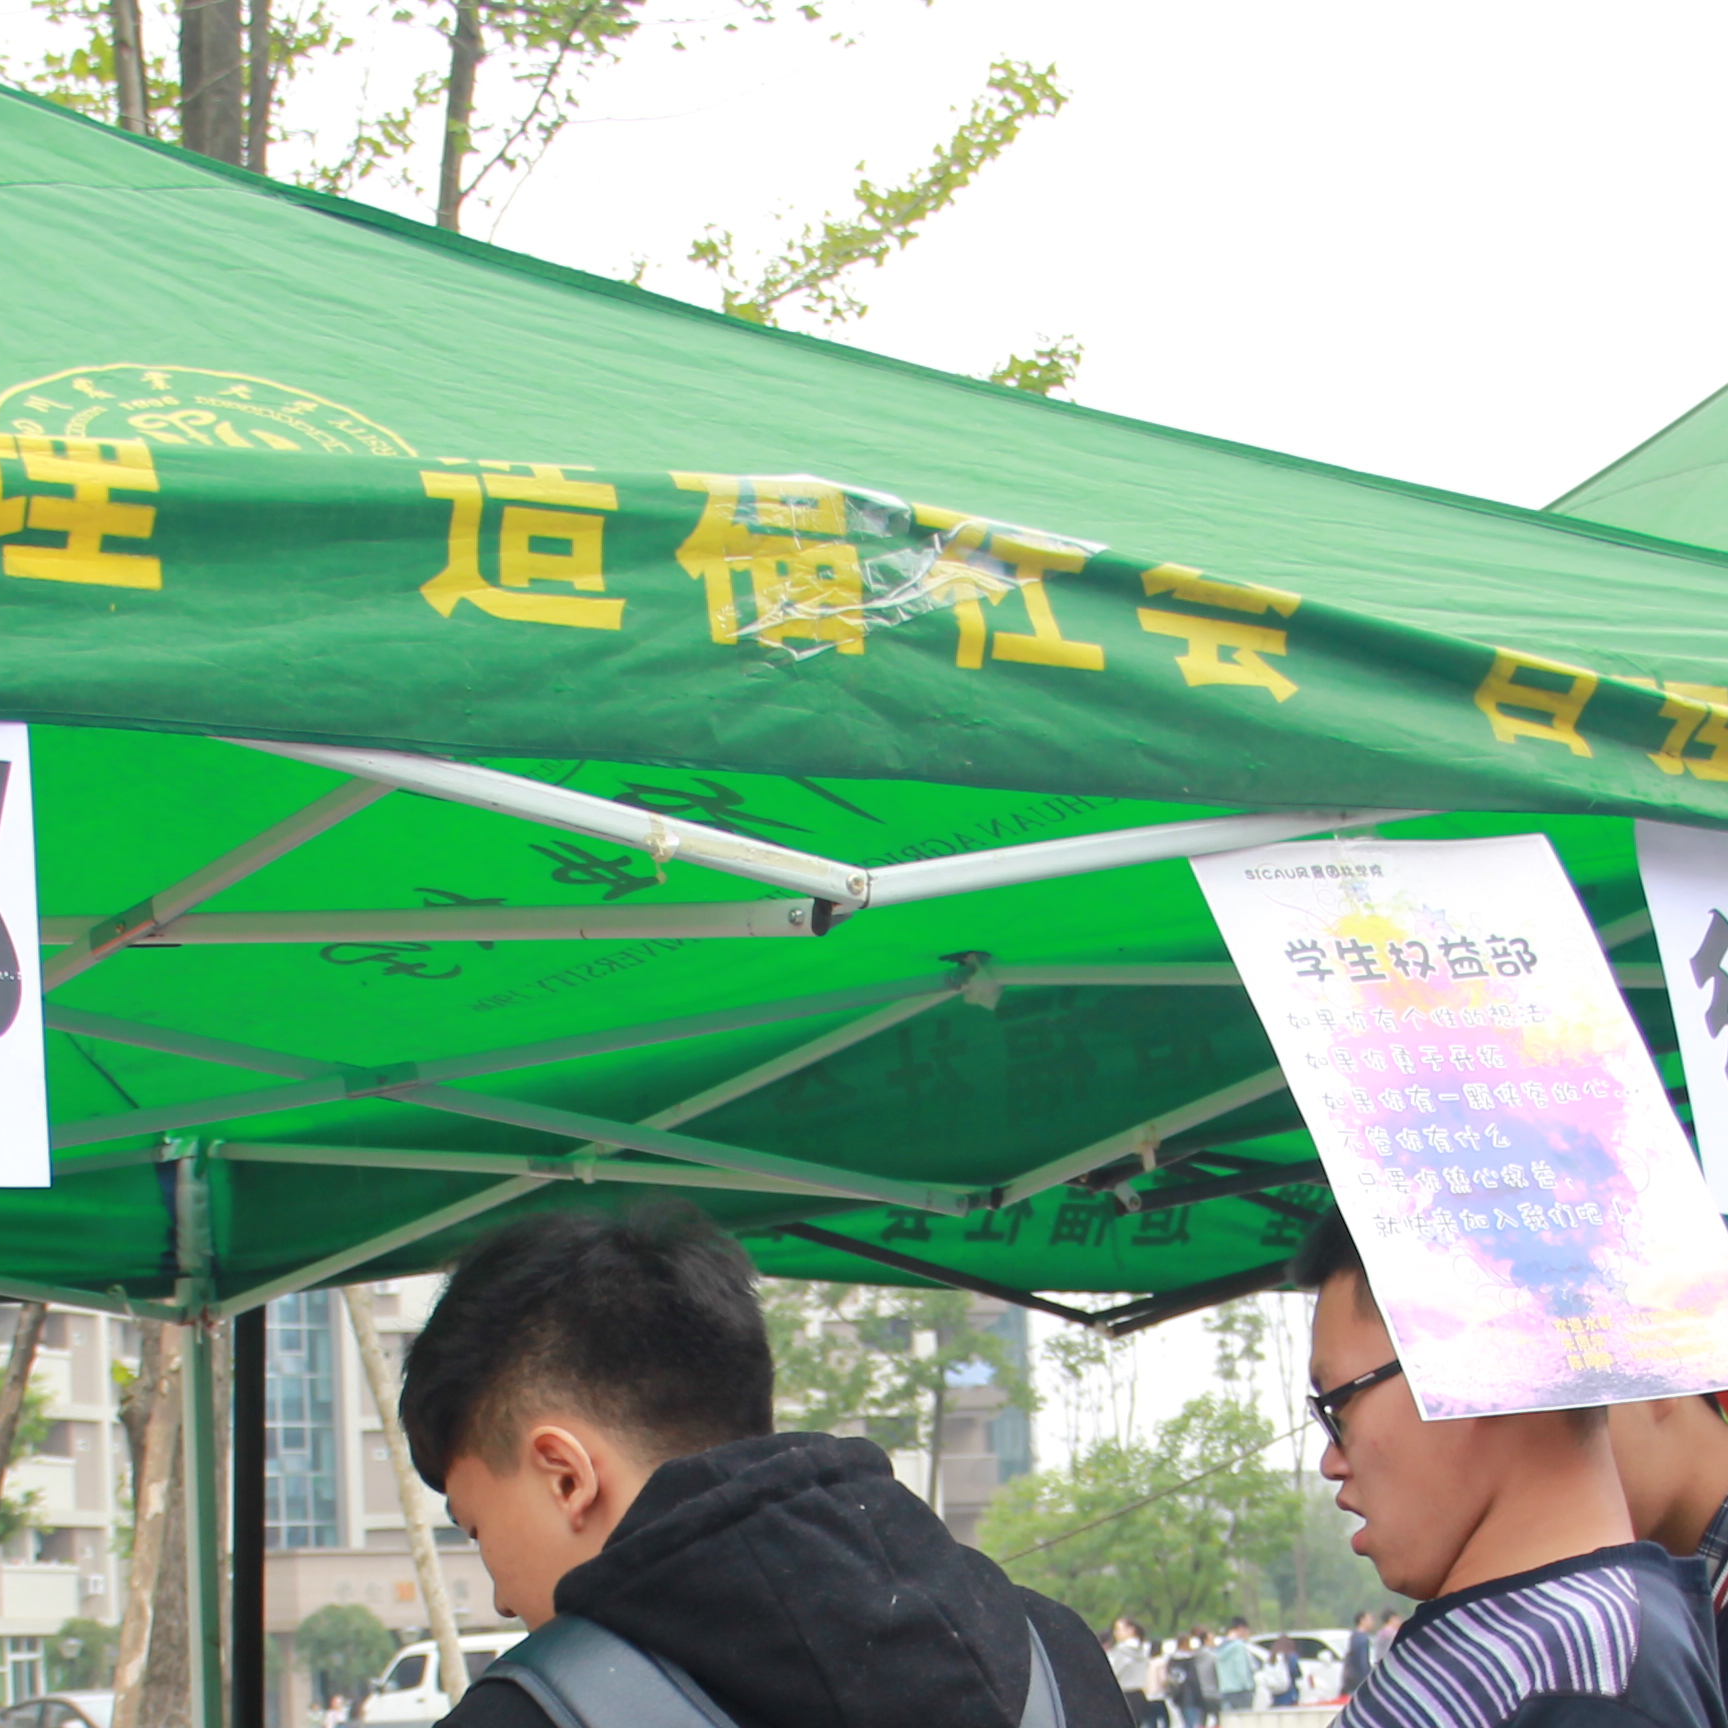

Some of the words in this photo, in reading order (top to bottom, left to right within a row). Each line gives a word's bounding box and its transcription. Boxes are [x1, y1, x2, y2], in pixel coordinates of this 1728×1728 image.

[1283, 935, 1538, 984] 学生权益部
